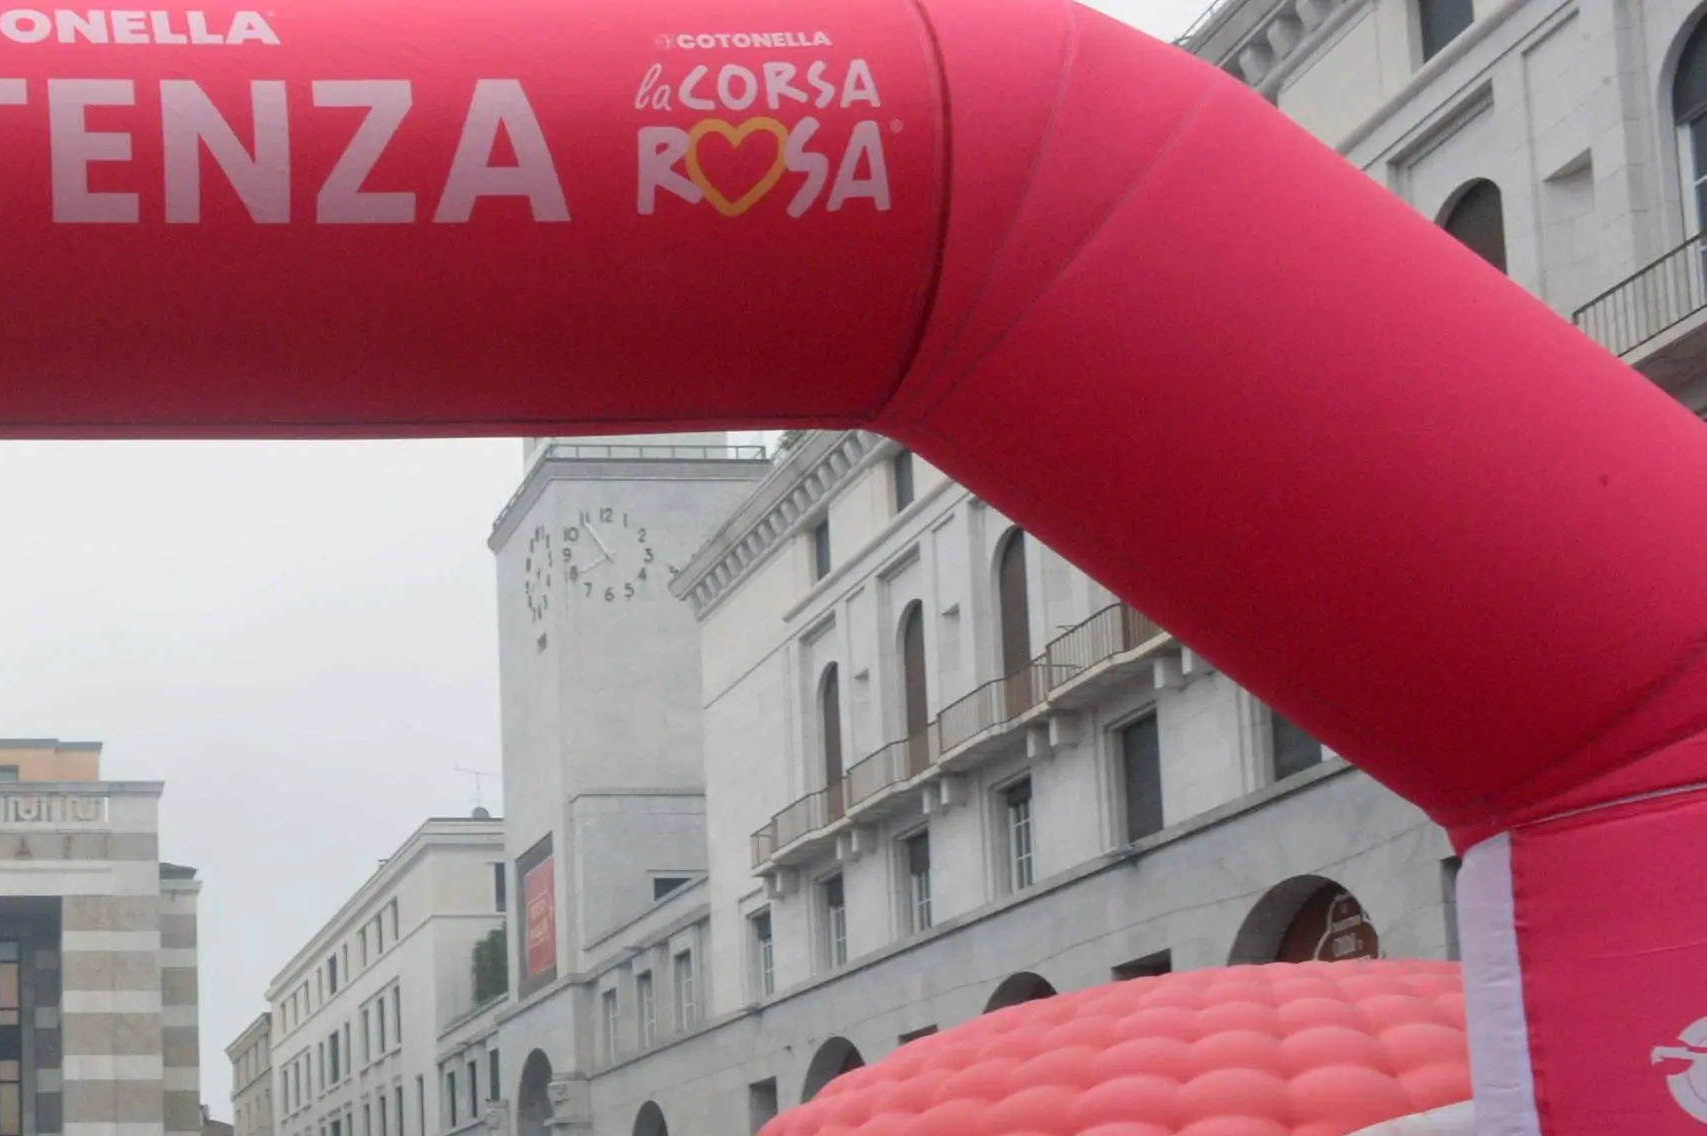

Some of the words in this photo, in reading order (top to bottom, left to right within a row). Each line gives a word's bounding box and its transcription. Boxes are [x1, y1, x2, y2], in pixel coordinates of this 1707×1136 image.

[677, 31, 833, 49] COTONELLA
[634, 63, 672, 111] la
[678, 58, 881, 110] CORSA
[600, 508, 613, 523] 12
[563, 527, 579, 542] 10
